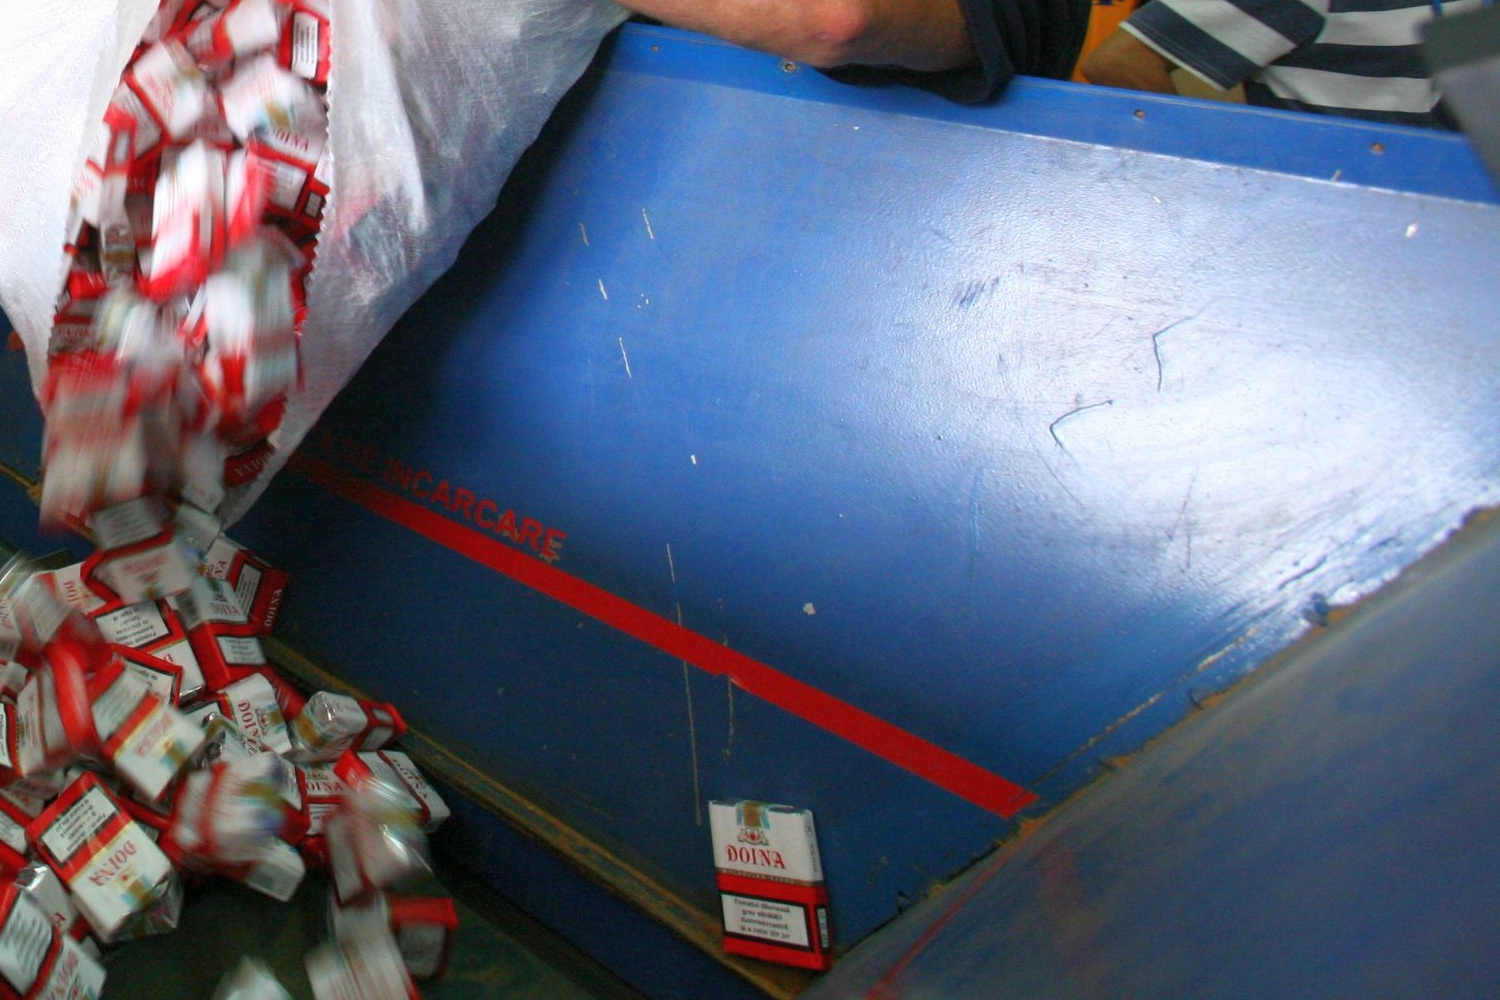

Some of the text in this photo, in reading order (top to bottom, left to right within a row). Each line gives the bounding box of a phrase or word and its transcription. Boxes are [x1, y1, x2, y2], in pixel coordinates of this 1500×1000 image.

[382, 457, 569, 560] INCARCARE
[263, 587, 283, 627] DOINA
[87, 840, 137, 888] DOINA
[726, 844, 787, 870] DOINA
